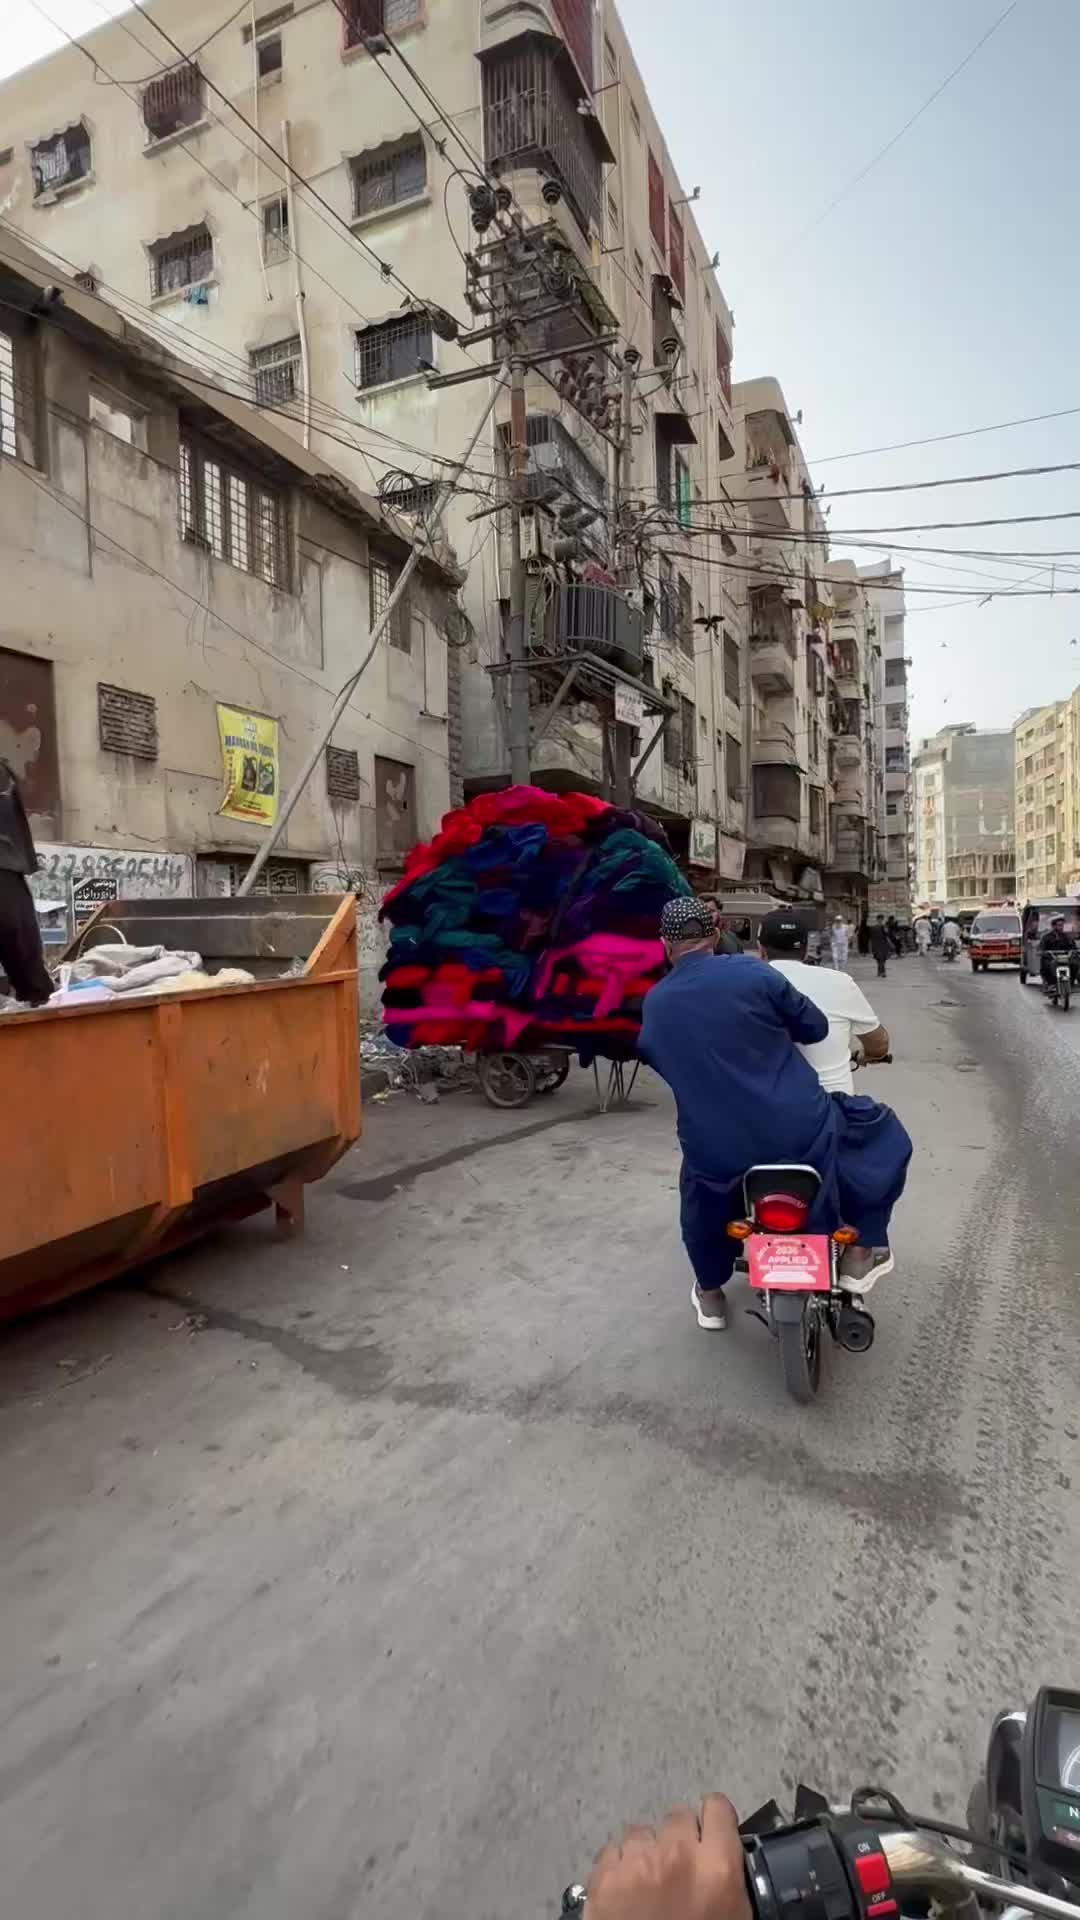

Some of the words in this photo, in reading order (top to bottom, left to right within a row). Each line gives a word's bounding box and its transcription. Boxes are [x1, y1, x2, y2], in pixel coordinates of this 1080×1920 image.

[768, 1255, 808, 1265] APPLIED
[857, 1842, 871, 1853] ON
[871, 1891, 886, 1903] OFF
